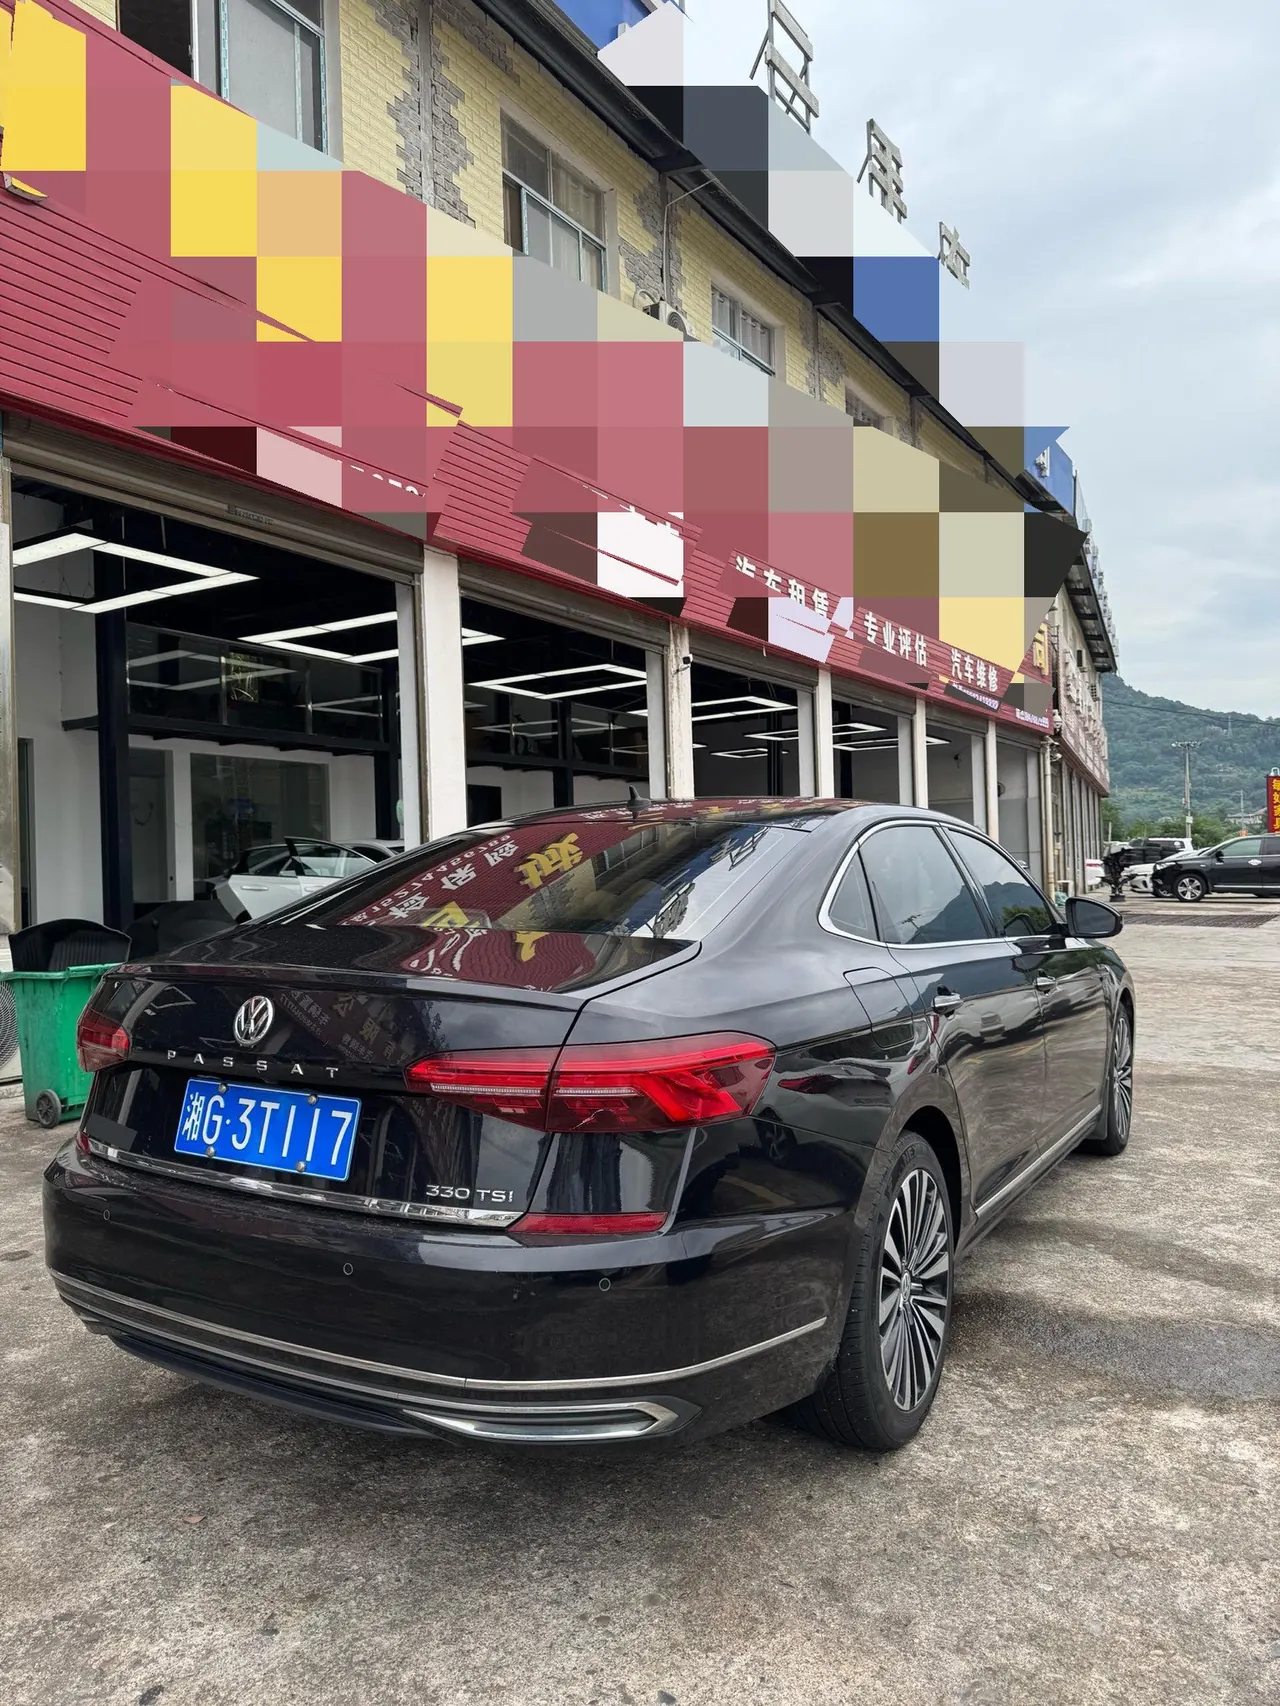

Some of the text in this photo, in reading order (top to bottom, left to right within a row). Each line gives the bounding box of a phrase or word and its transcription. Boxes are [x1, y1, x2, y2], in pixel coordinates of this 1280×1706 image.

[863, 611, 928, 668] 专业评估
[950, 647, 999, 693] 汽车维修
[167, 1049, 339, 1079] PASSAT
[425, 1184, 514, 1203] 330 TSI
